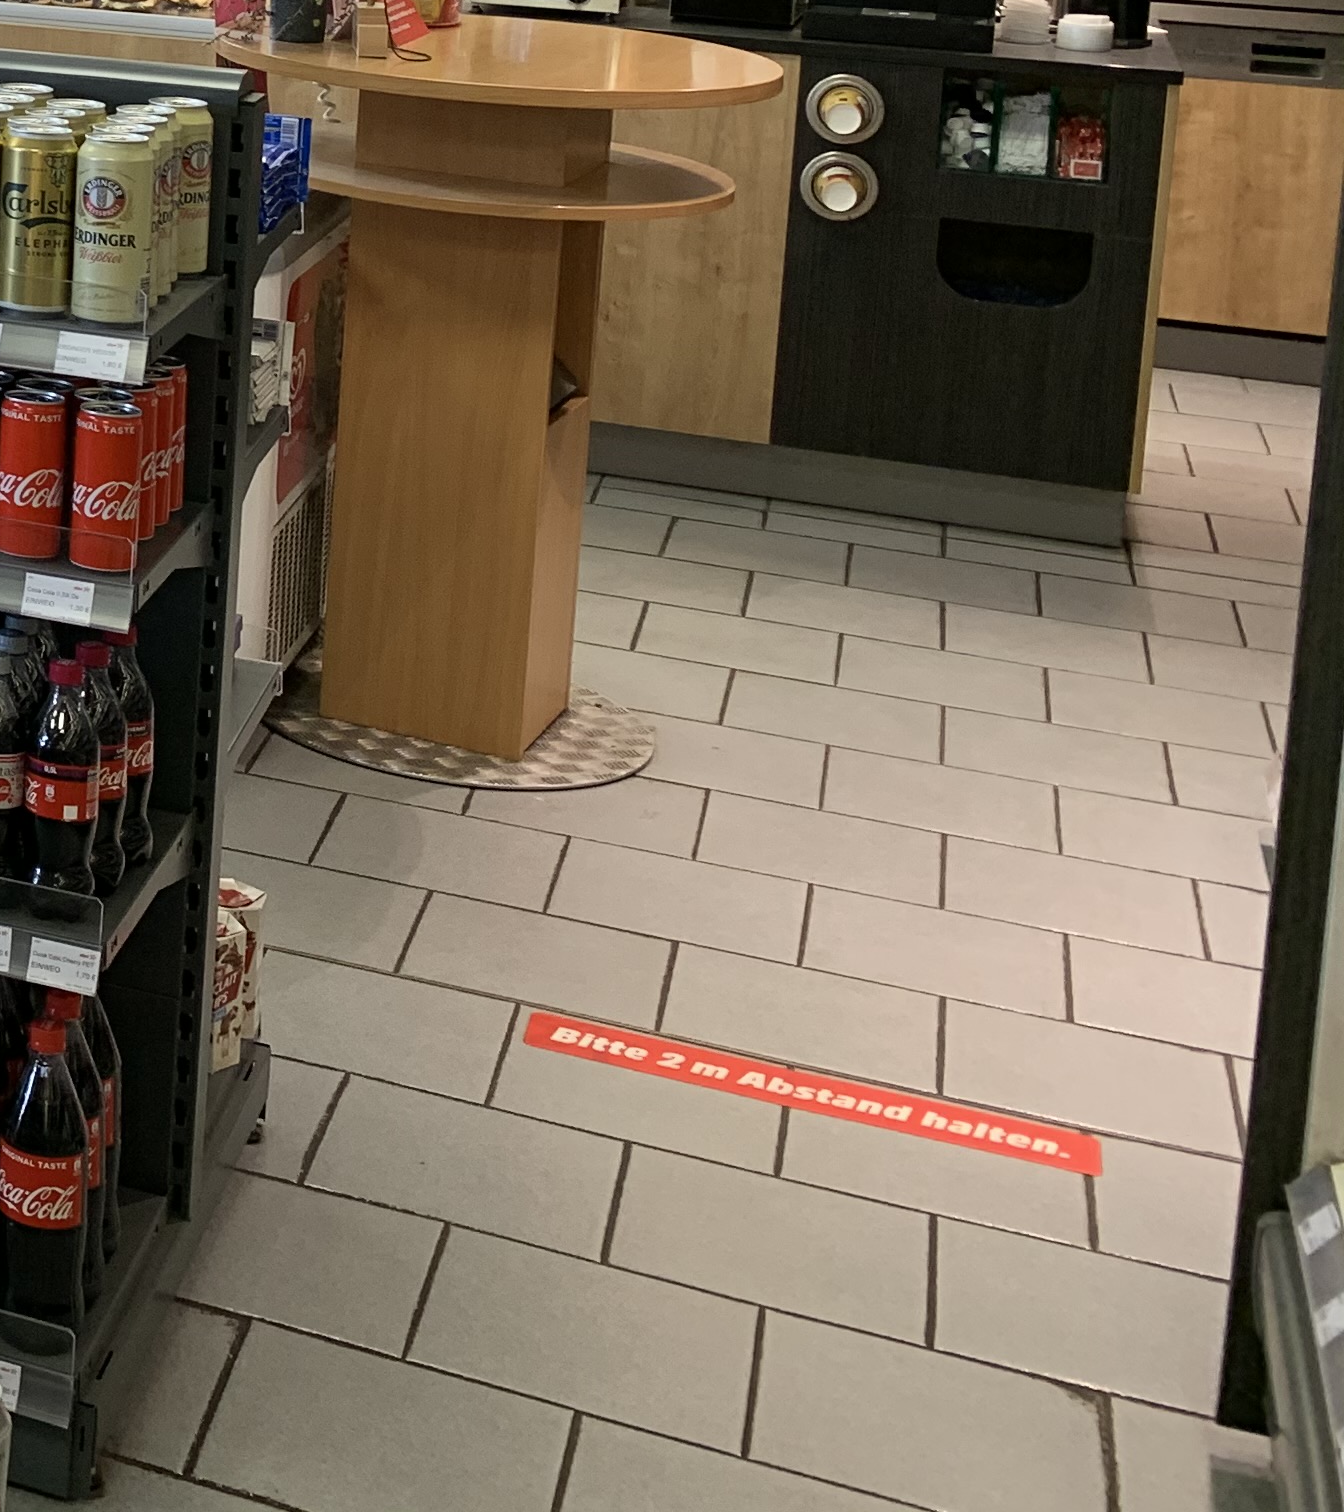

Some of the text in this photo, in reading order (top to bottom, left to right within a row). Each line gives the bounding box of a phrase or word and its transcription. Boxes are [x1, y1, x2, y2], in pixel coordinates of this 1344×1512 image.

[74, 226, 136, 249] ERDINGER
[79, 247, 122, 263] Weißbier
[33, 413, 62, 423] TASTE
[103, 425, 135, 435] TASTE
[31, 961, 60, 973] EINWEG
[549, 1026, 1071, 1160] Bitte 2 m Abstand halten.
[1, 1143, 68, 1172] ORIGINAL TASTE
